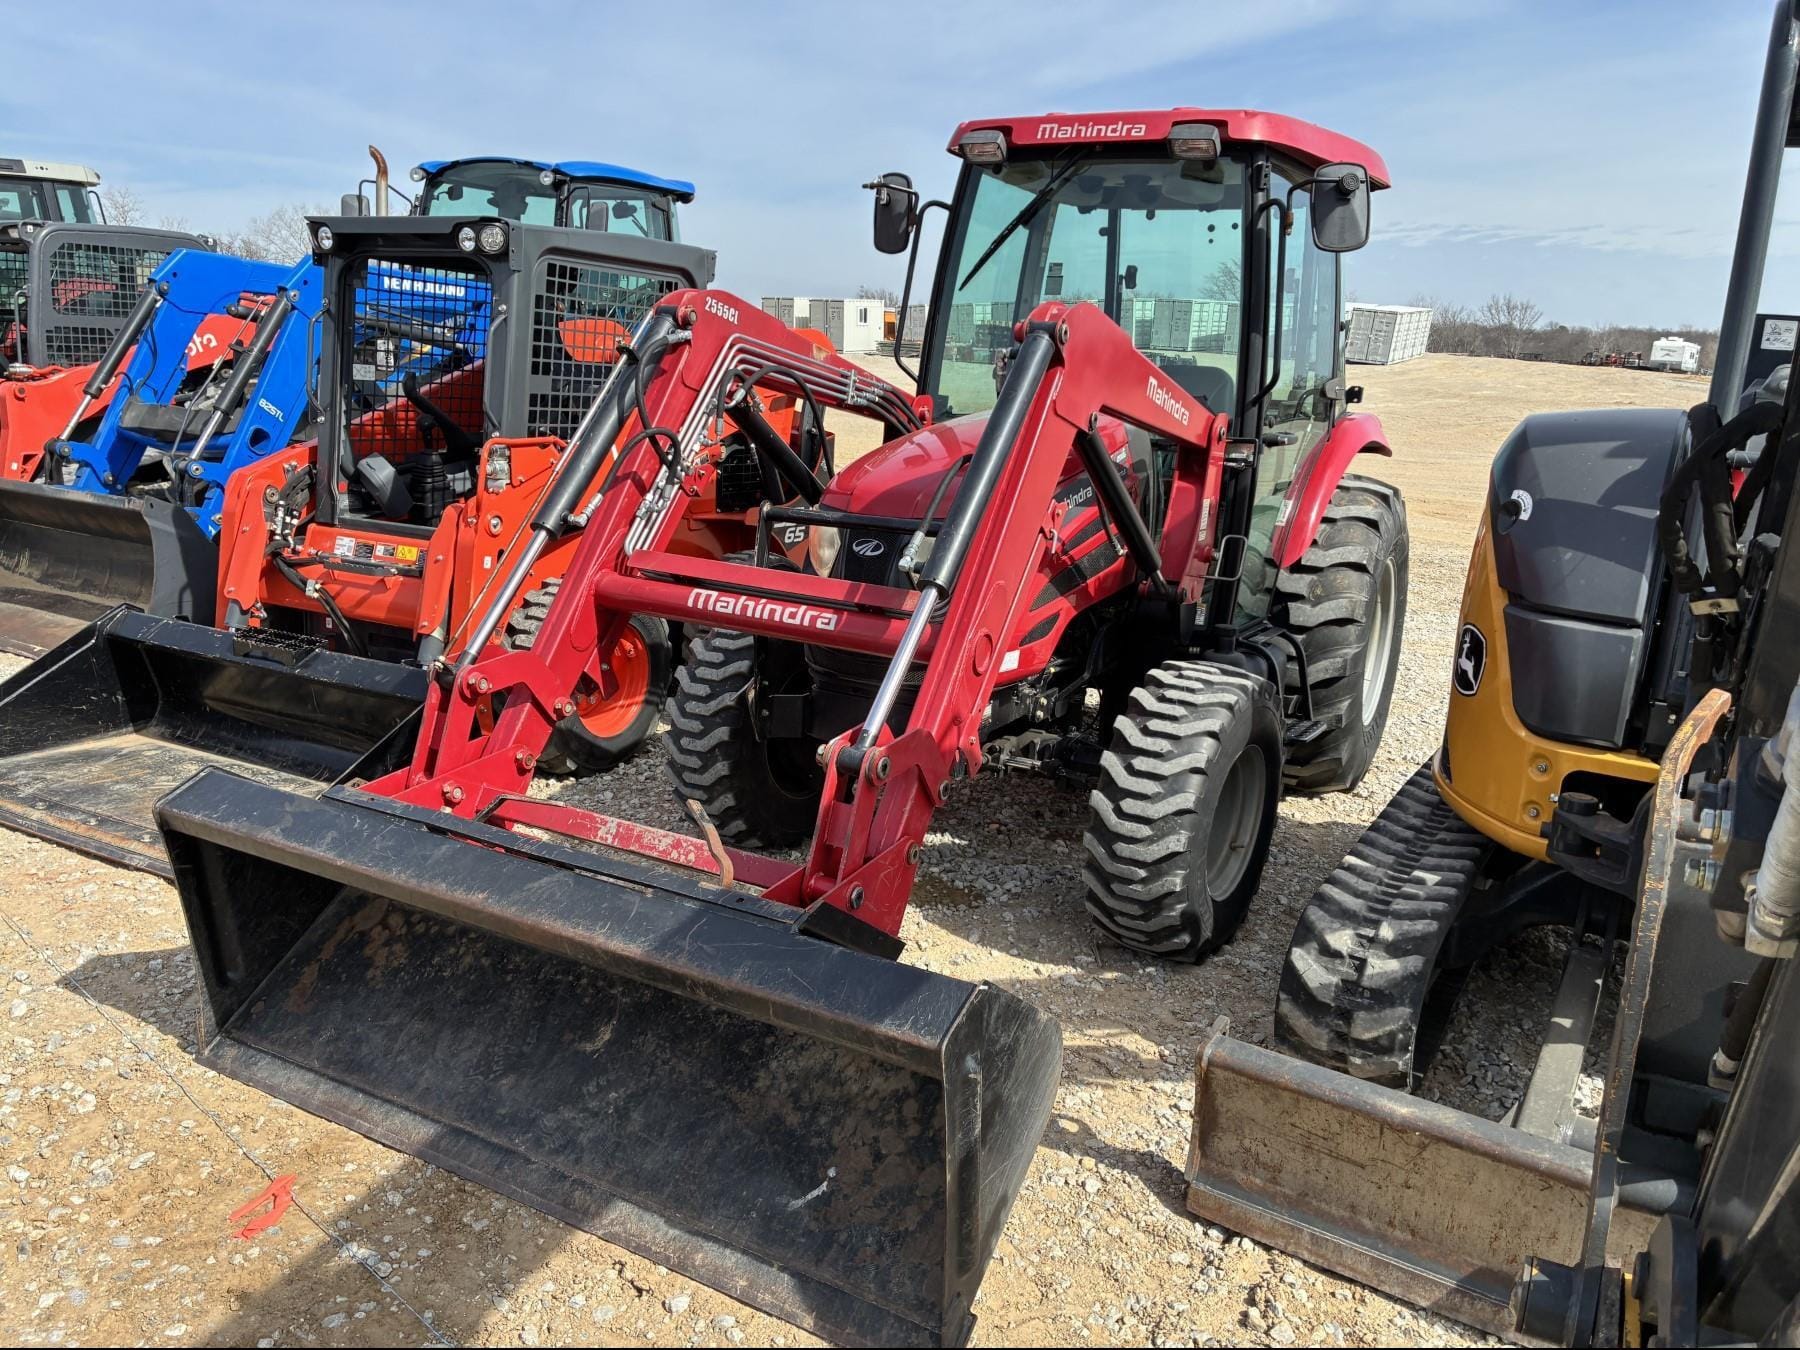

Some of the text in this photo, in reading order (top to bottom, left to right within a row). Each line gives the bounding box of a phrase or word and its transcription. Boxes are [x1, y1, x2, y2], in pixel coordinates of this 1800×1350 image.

[1037, 121, 1146, 139] Mahindra
[705, 296, 739, 325] 2555CL
[1147, 375, 1190, 426] Mahindra
[1064, 486, 1093, 510] hindra
[784, 526, 806, 543] 65
[687, 588, 838, 631] Mahindra
